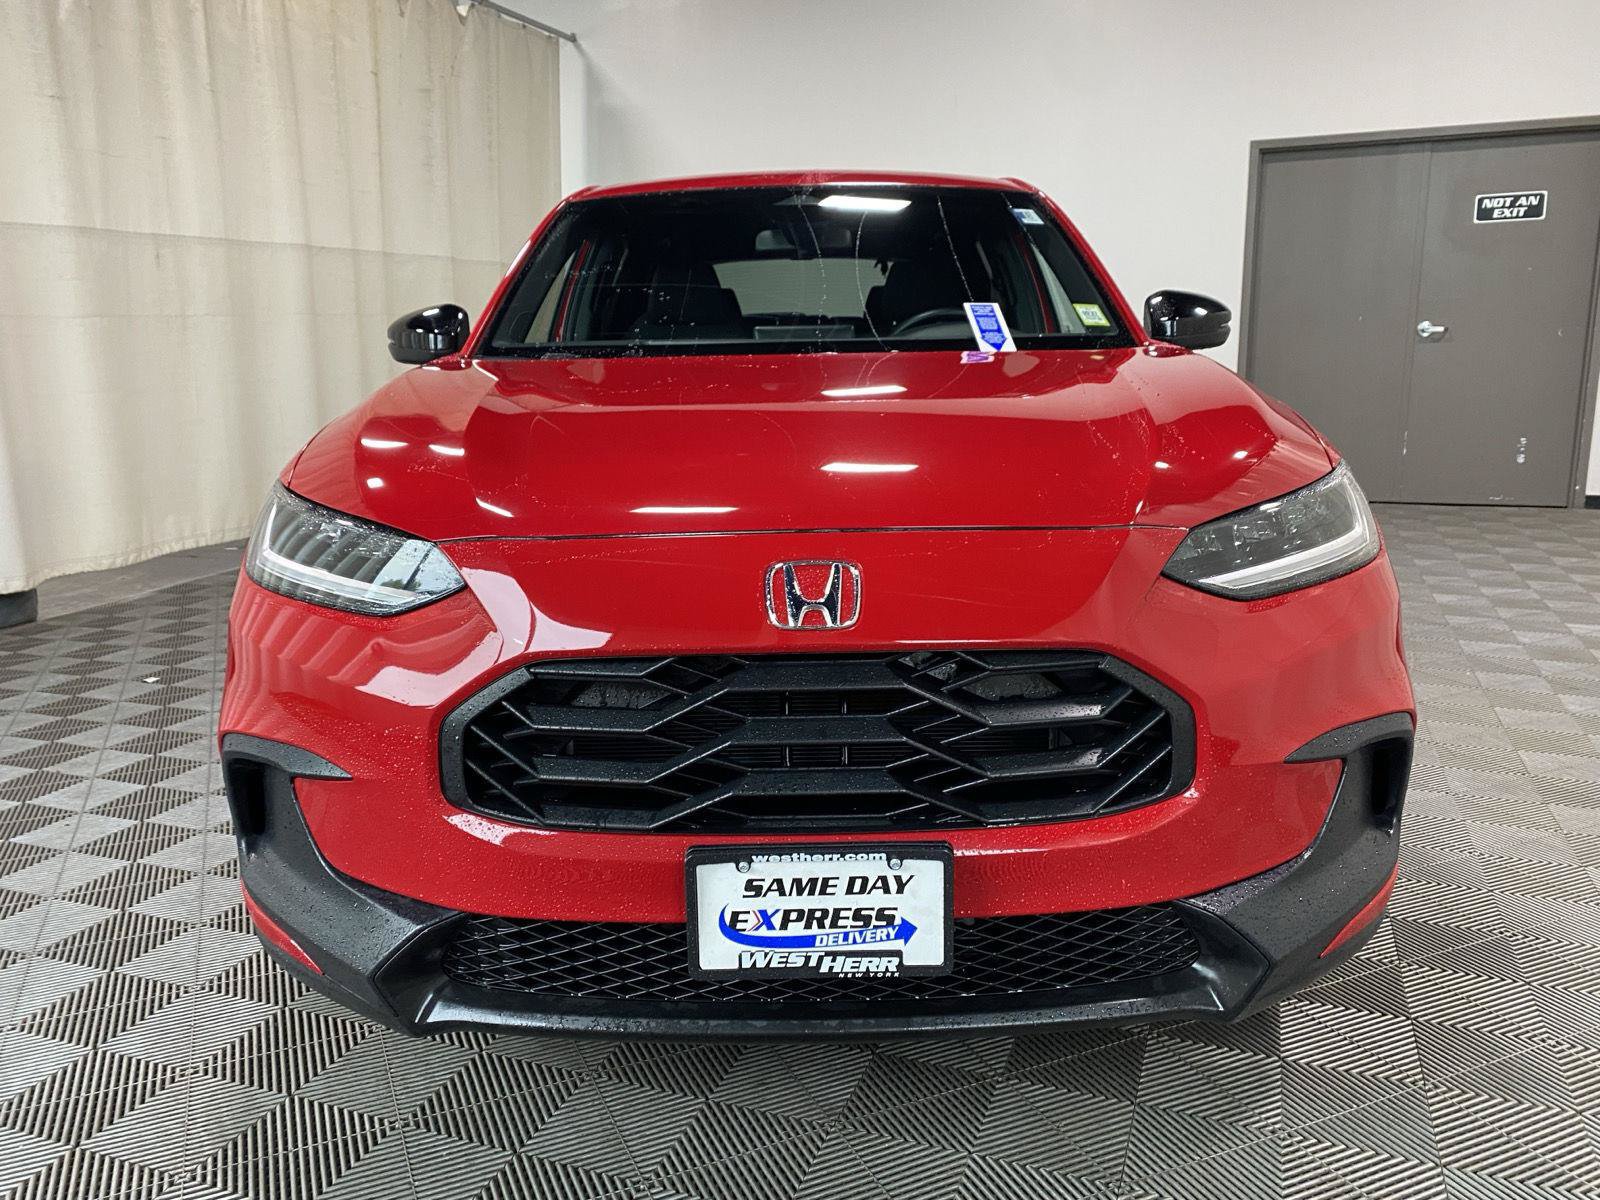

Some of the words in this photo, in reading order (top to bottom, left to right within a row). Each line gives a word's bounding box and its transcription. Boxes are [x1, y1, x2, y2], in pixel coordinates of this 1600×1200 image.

[1481, 197, 1514, 209] NOT
[1515, 195, 1540, 206] AN
[1492, 207, 1528, 218] EXIT
[751, 852, 887, 863] westherr.com
[743, 876, 840, 898] SAME
[845, 875, 915, 896] DAY
[728, 907, 899, 931] EXPRESS
[814, 926, 900, 948] DELIVERY
